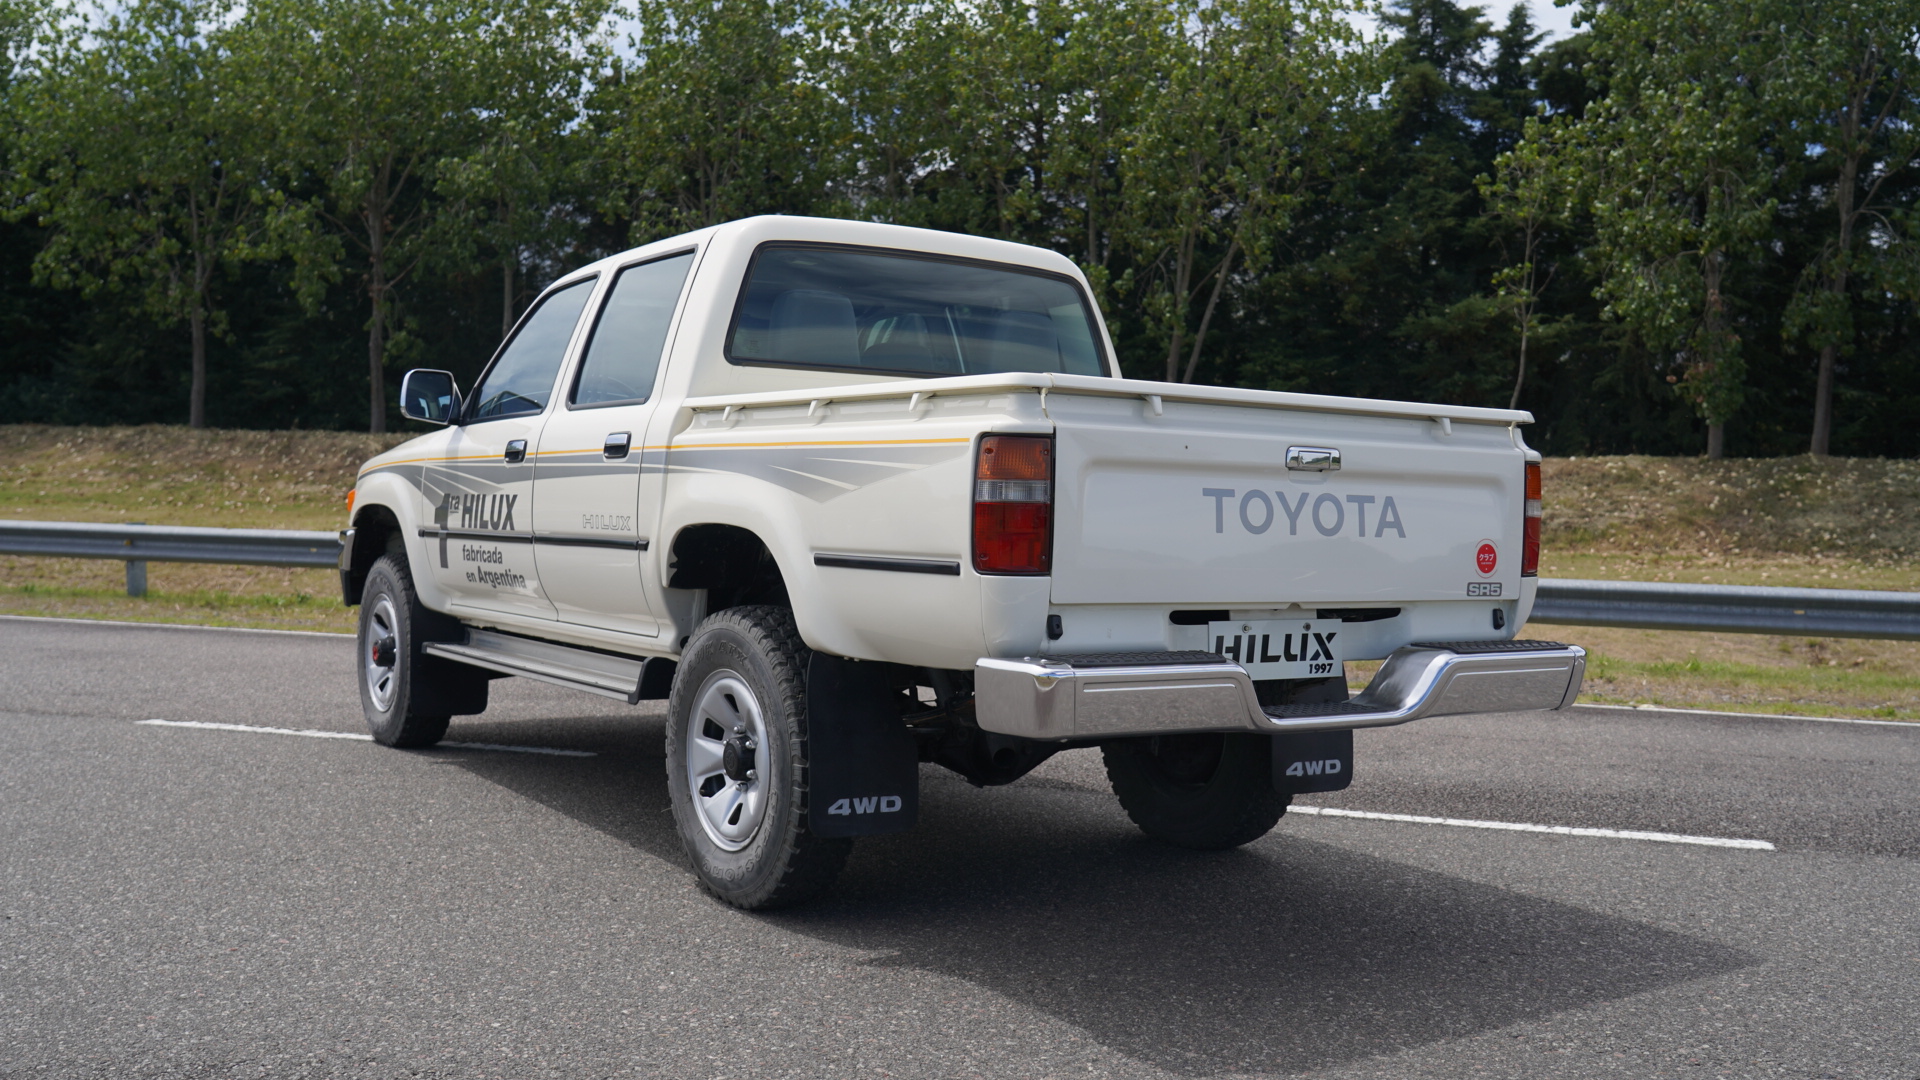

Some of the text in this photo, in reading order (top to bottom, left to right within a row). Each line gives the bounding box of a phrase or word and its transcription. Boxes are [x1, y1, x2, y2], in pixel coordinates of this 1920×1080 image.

[461, 493, 518, 531] HILUX
[582, 514, 631, 531] HILUX
[1202, 487, 1406, 538] TOYOTA
[462, 544, 503, 565] fabricada
[466, 565, 527, 589] en Argentina
[1468, 584, 1501, 595] SR5
[1214, 631, 1337, 663] HILUX
[1308, 663, 1333, 675] 1997
[1286, 759, 1341, 776] 4WD
[827, 795, 902, 816] 4WD
